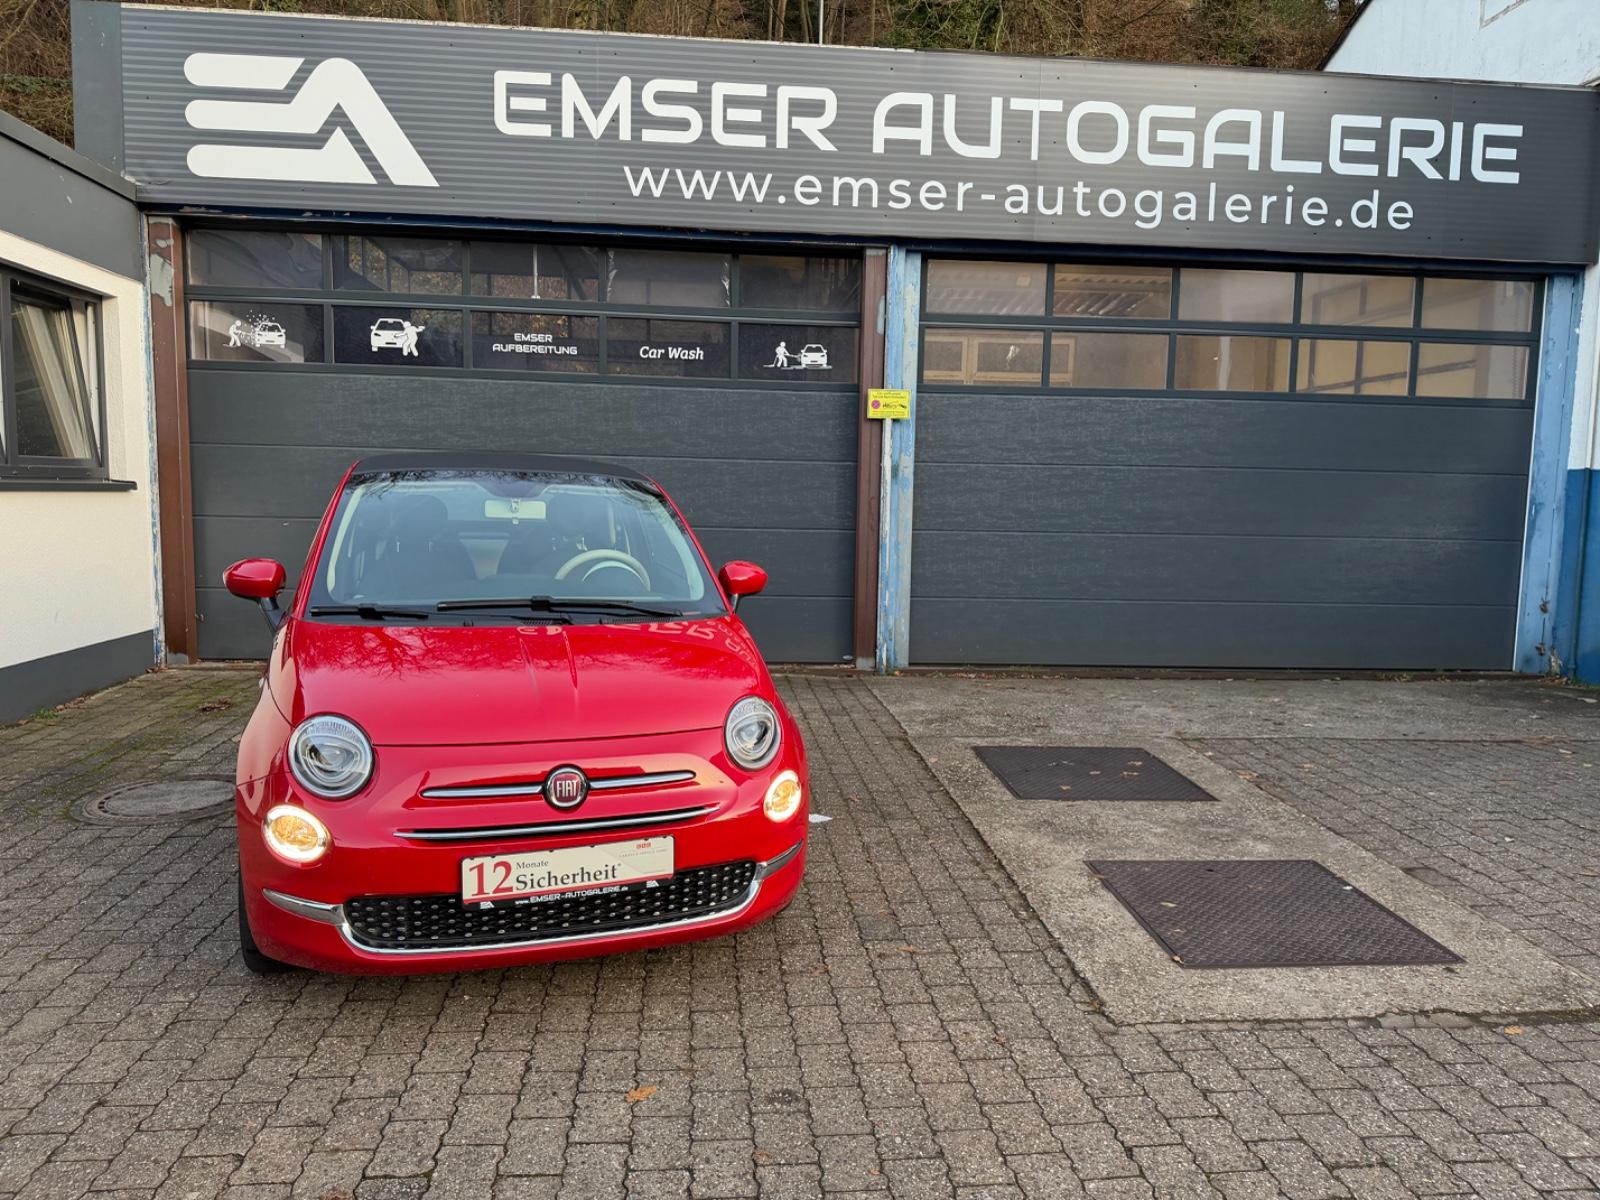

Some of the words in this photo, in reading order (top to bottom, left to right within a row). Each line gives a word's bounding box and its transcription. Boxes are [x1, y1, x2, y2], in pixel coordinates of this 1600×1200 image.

[494, 70, 838, 152] EMSER
[873, 92, 1523, 184] AUTOGALERIE
[624, 166, 1414, 230] www.emser-autogalerie.de
[514, 333, 553, 343] EMSER
[492, 343, 578, 355] AUFBEREITUNG
[639, 346, 664, 359] Car
[668, 346, 704, 360] Wash
[556, 779, 578, 798] FIAT
[516, 860, 549, 870] Monate
[469, 861, 513, 896] 12
